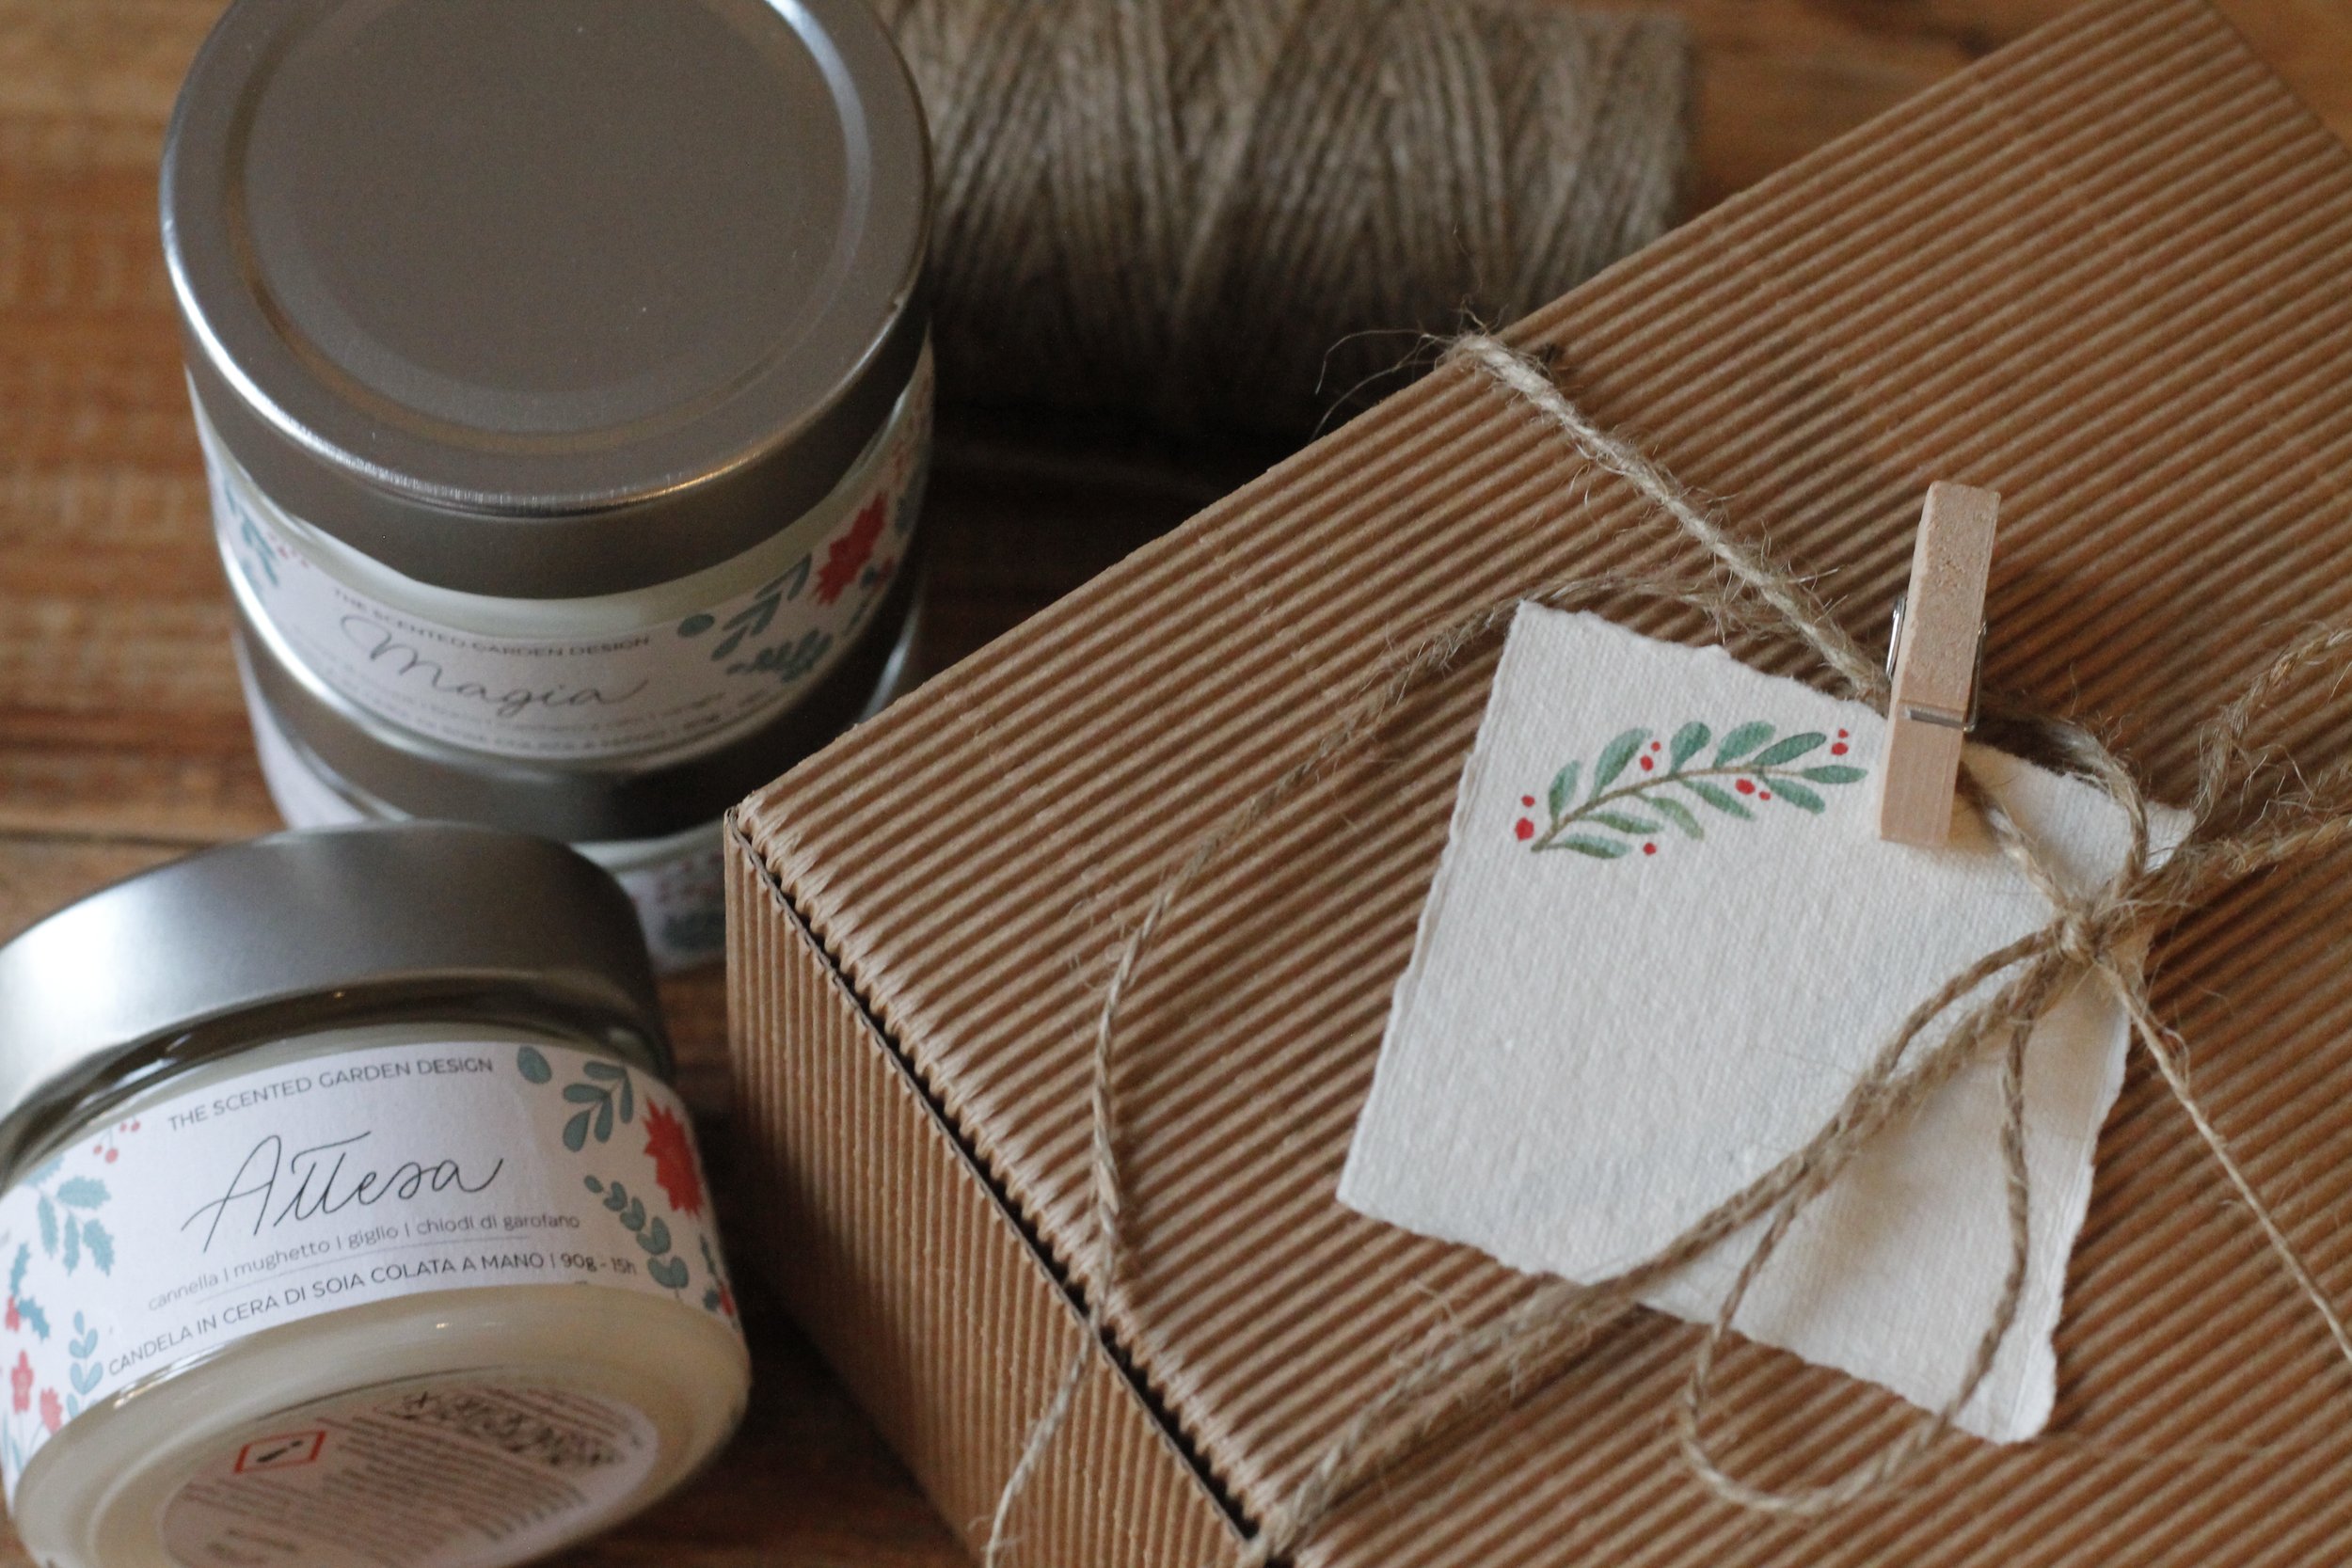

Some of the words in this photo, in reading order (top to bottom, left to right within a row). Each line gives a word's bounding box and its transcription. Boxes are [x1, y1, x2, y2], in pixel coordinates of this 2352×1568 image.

[341, 614, 648, 717] Magia
[373, 610, 467, 646] SCENTED
[471, 640, 564, 657] GARDEN
[568, 636, 650, 656] DESIGN
[168, 1104, 209, 1132] THE
[213, 1077, 312, 1117] SCENTED
[319, 1062, 412, 1088] GARDEN
[416, 1057, 493, 1075] DESIGN
[181, 1130, 504, 1253] Attesa
[148, 1275, 219, 1312] cannella
[233, 1239, 330, 1278] mughetto
[349, 1226, 399, 1249] giglio
[417, 1217, 475, 1235] chiodi
[481, 1216, 498, 1230] di
[503, 1213, 580, 1233] garofano
[108, 1324, 194, 1376] CANDELA
[197, 1314, 217, 1335] IN
[223, 1294, 280, 1324] CERA
[284, 1285, 307, 1306] DI
[313, 1274, 366, 1298] SOIA
[371, 1259, 456, 1284] COLATA
[462, 1257, 477, 1272] A
[482, 1253, 545, 1269] MANO
